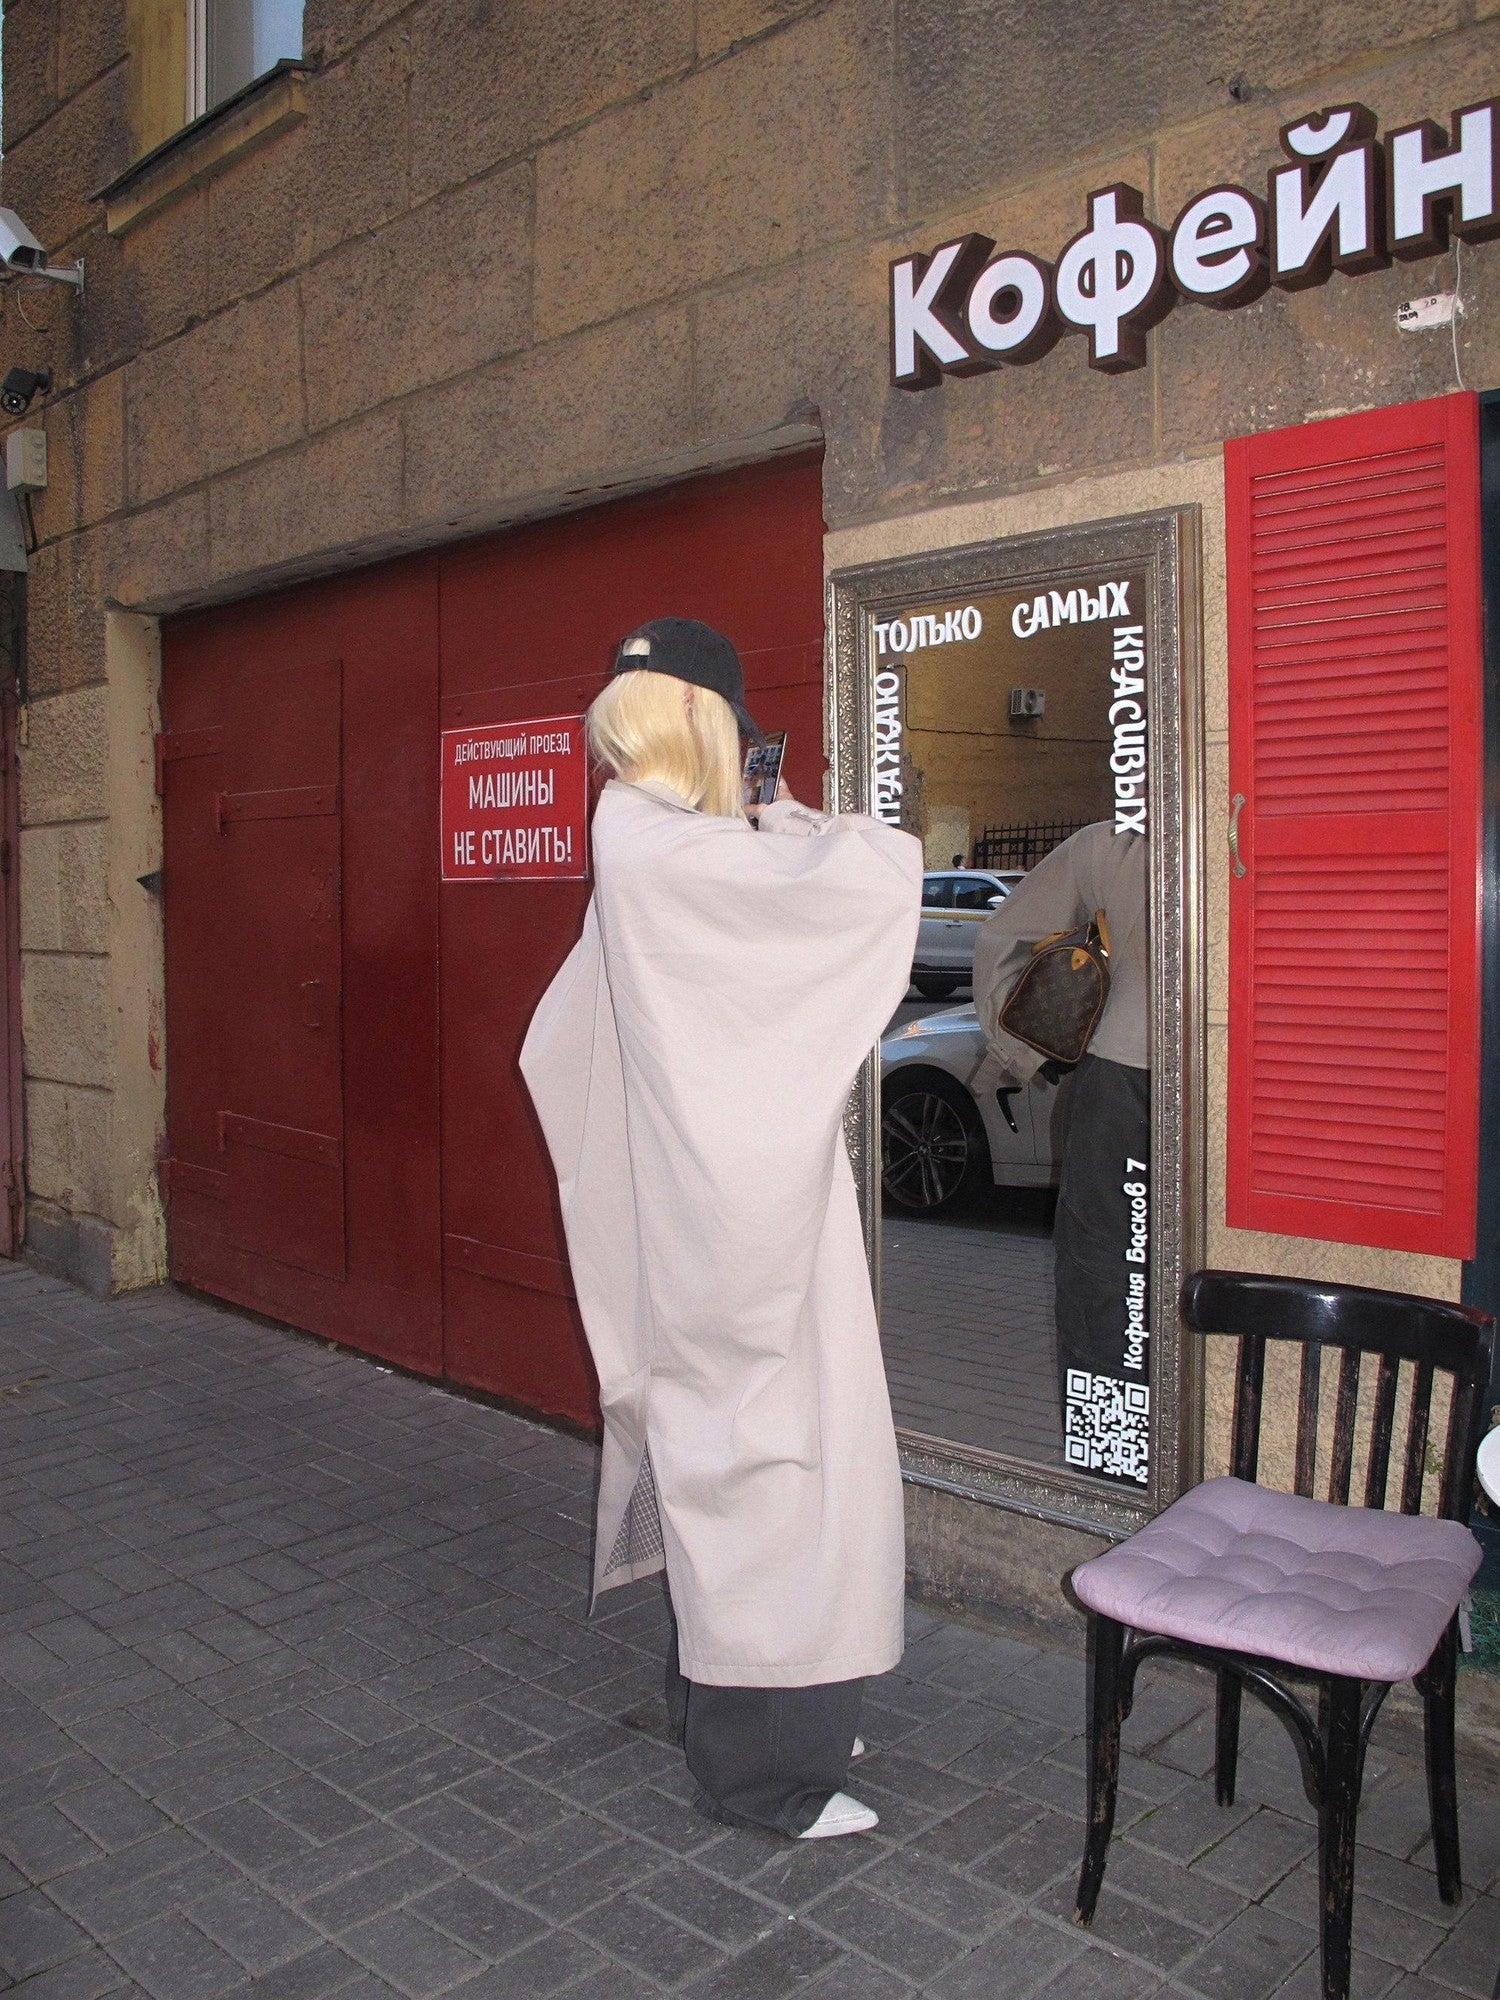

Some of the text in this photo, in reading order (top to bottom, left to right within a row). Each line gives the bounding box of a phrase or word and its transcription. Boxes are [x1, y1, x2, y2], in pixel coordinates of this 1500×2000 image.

[890, 98, 1499, 390] Кофейн
[873, 581, 1131, 654] ТОЛЬКО САМЫХ
[454, 732, 571, 765] ДЕЙСТВУЮЩИЙ ПРОЕЗД
[1108, 625, 1147, 835] КРАСИВЫХ
[469, 769, 554, 810] МАШИНЫ
[454, 826, 572, 865] НЕ СТАВИТЬ!
[1123, 1157, 1149, 1371] Кофейня Басков 7
